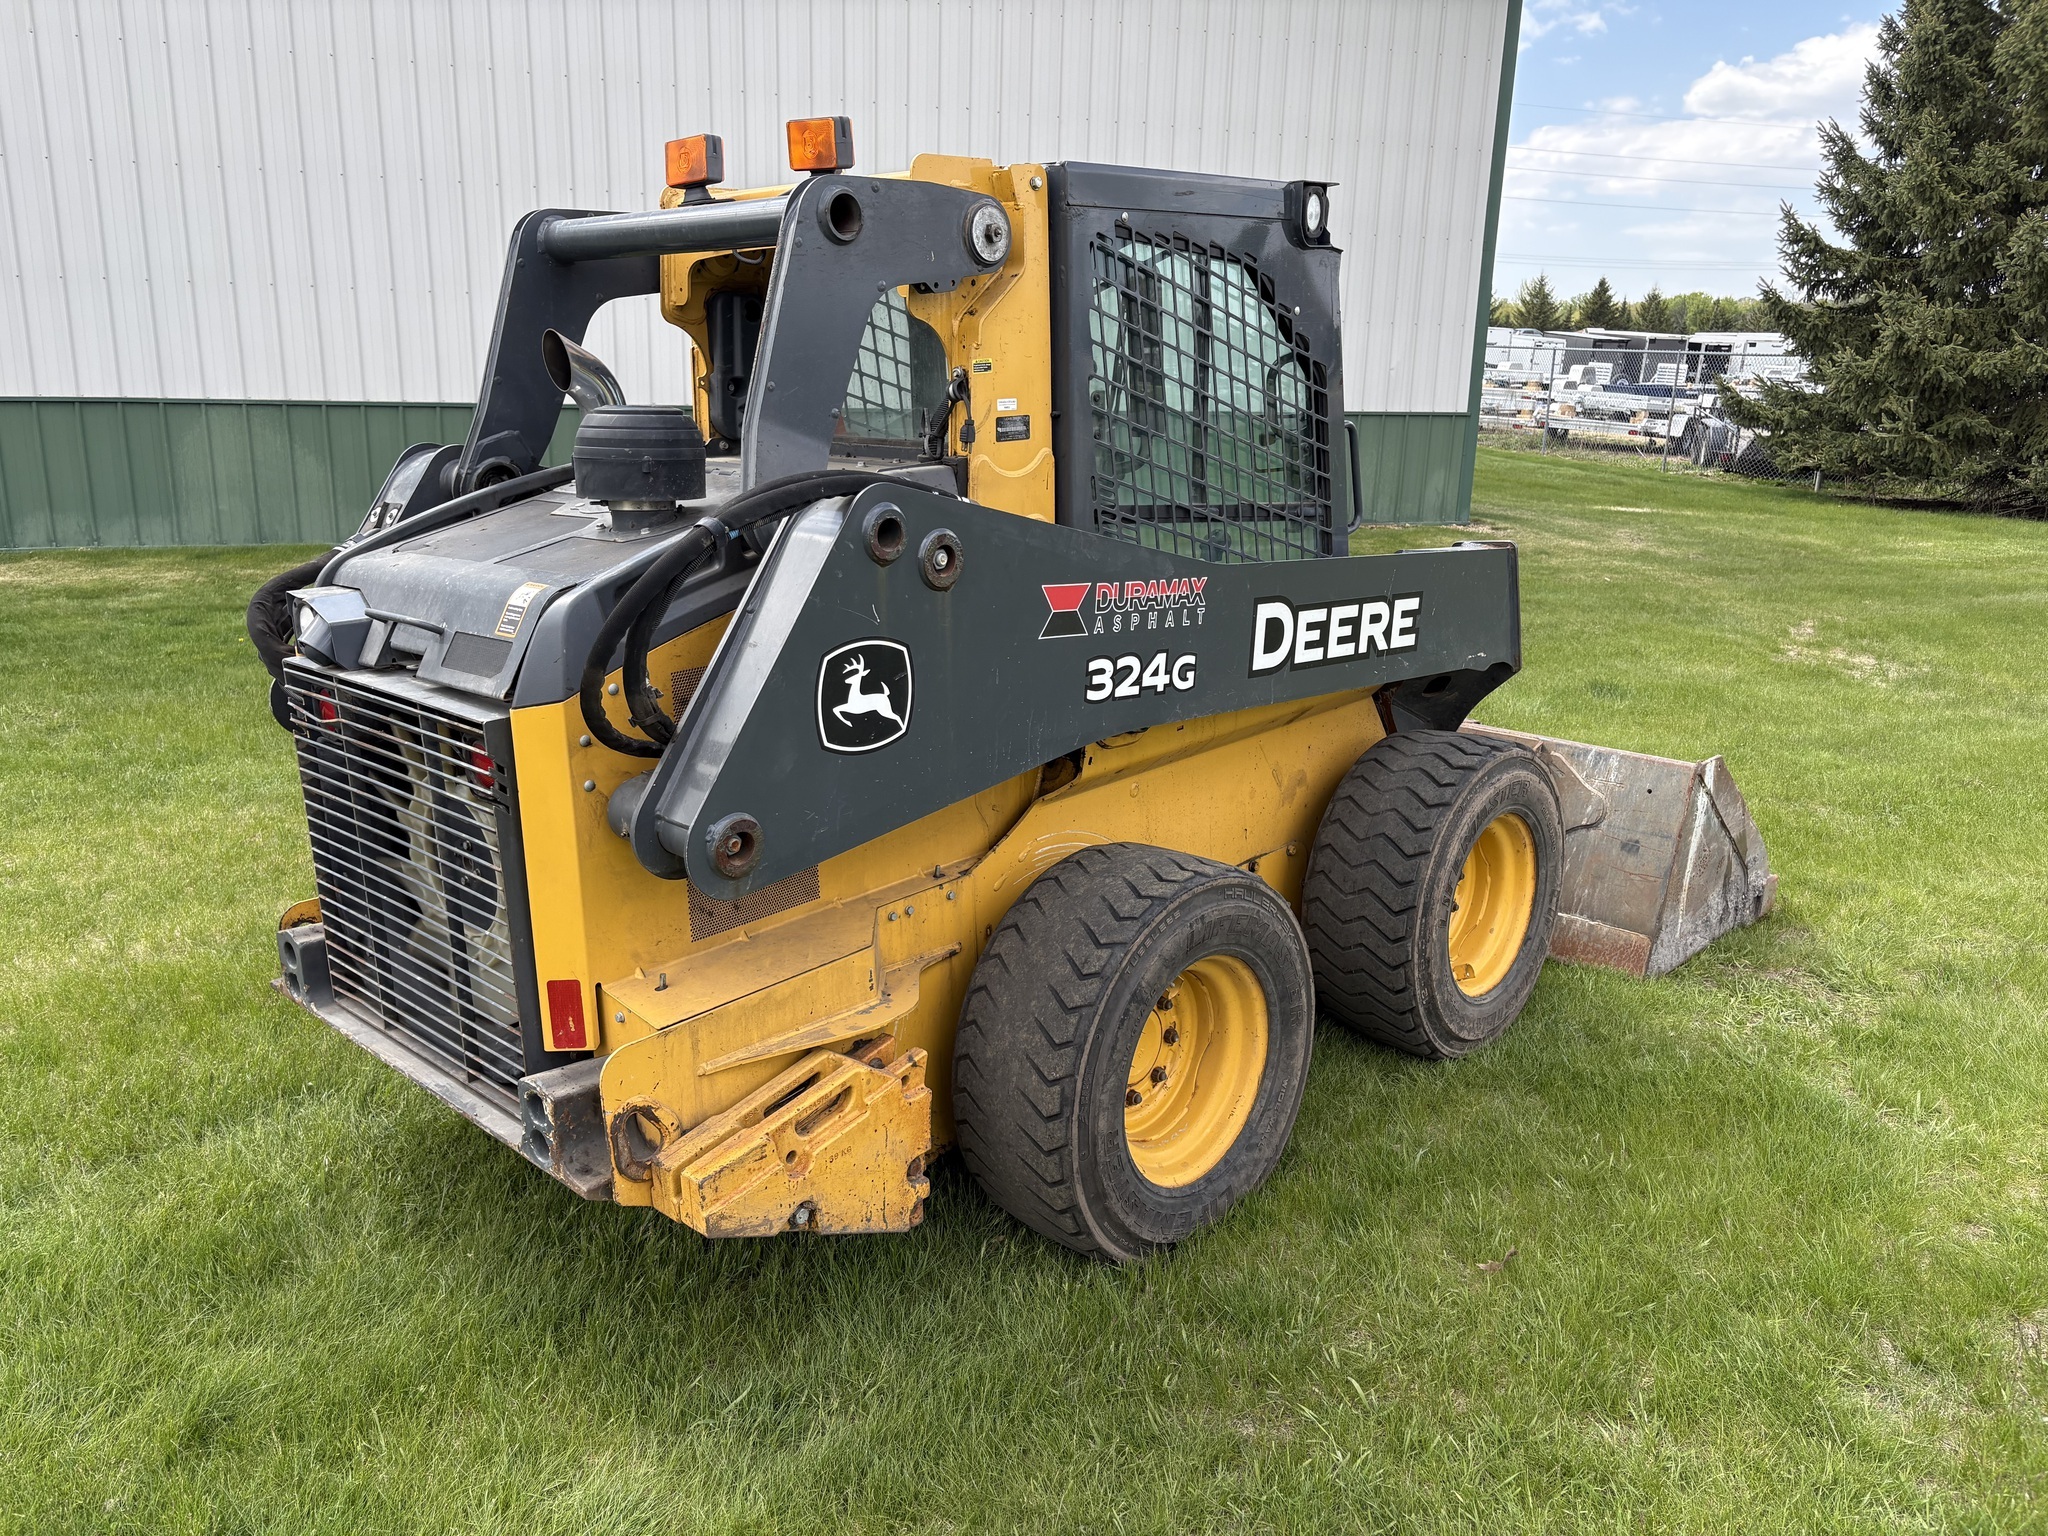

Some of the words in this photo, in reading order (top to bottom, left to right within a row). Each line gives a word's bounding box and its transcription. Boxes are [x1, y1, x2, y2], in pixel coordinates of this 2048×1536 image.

[1093, 608, 1206, 634] ASPHALT
[1095, 577, 1208, 614] DURAMAX
[1252, 597, 1420, 671] DEERE
[1086, 652, 1196, 701] 324G
[1124, 909, 1181, 975] TUBELESS
[1186, 912, 1306, 1030] LIFEMASTER
